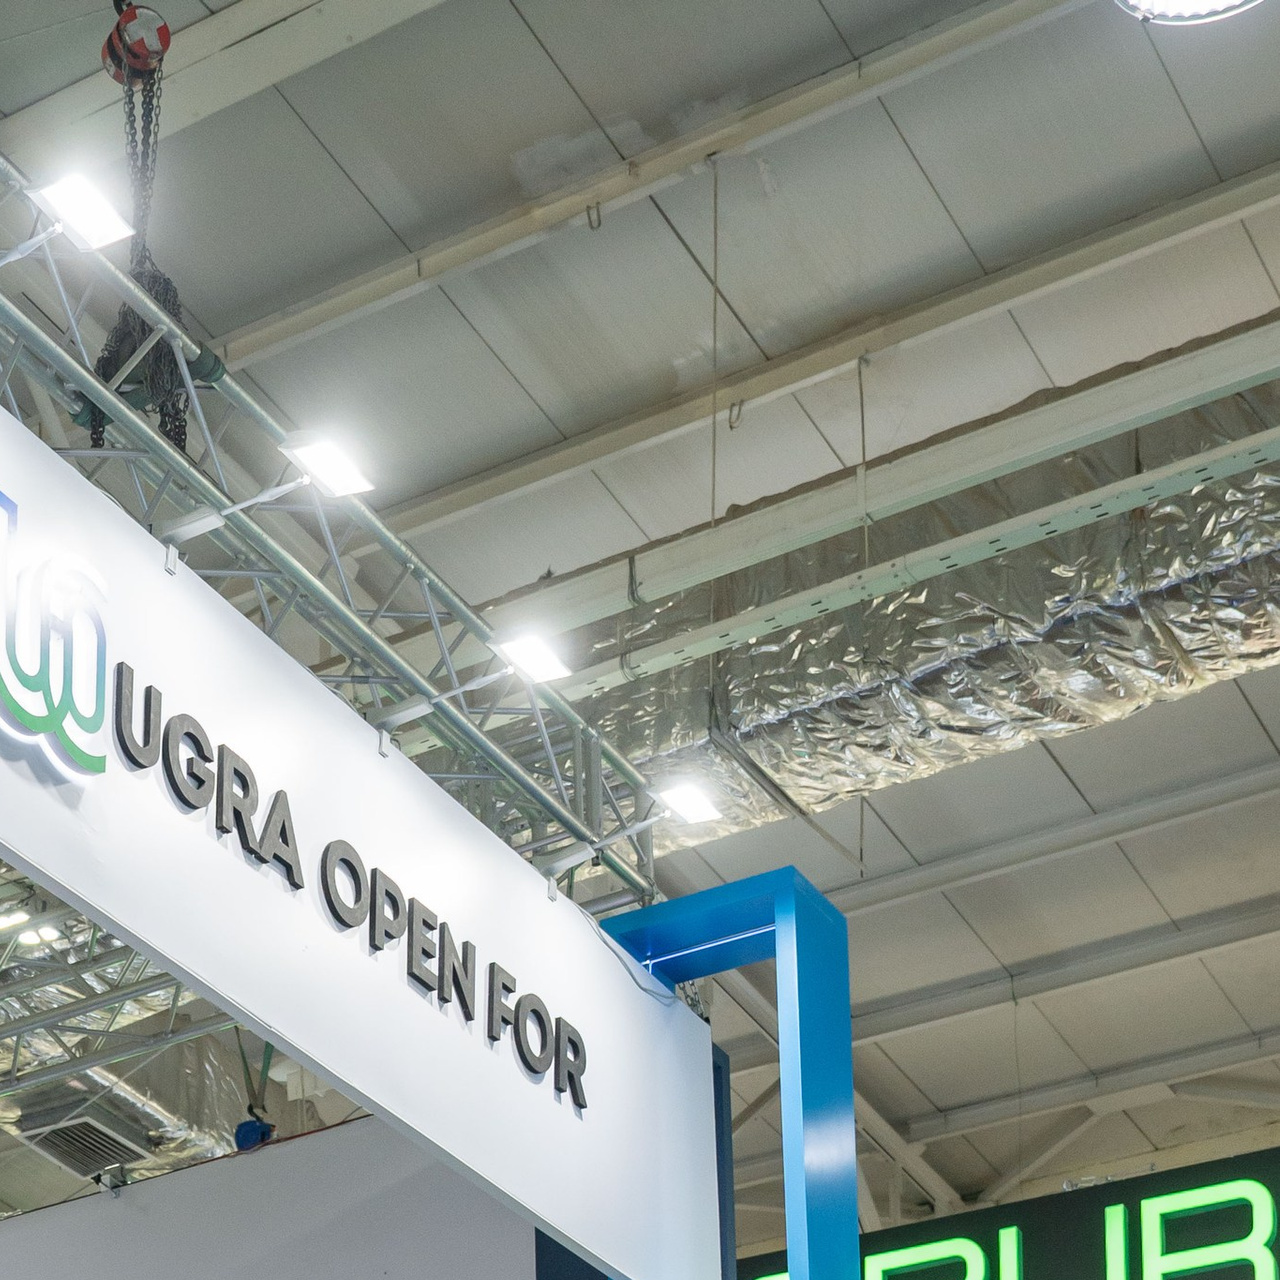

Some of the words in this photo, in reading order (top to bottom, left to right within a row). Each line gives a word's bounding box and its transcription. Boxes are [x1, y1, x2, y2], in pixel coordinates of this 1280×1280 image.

[113, 660, 304, 890] UGRA
[320, 839, 476, 1022] OPEN
[486, 961, 587, 1110] FOR
